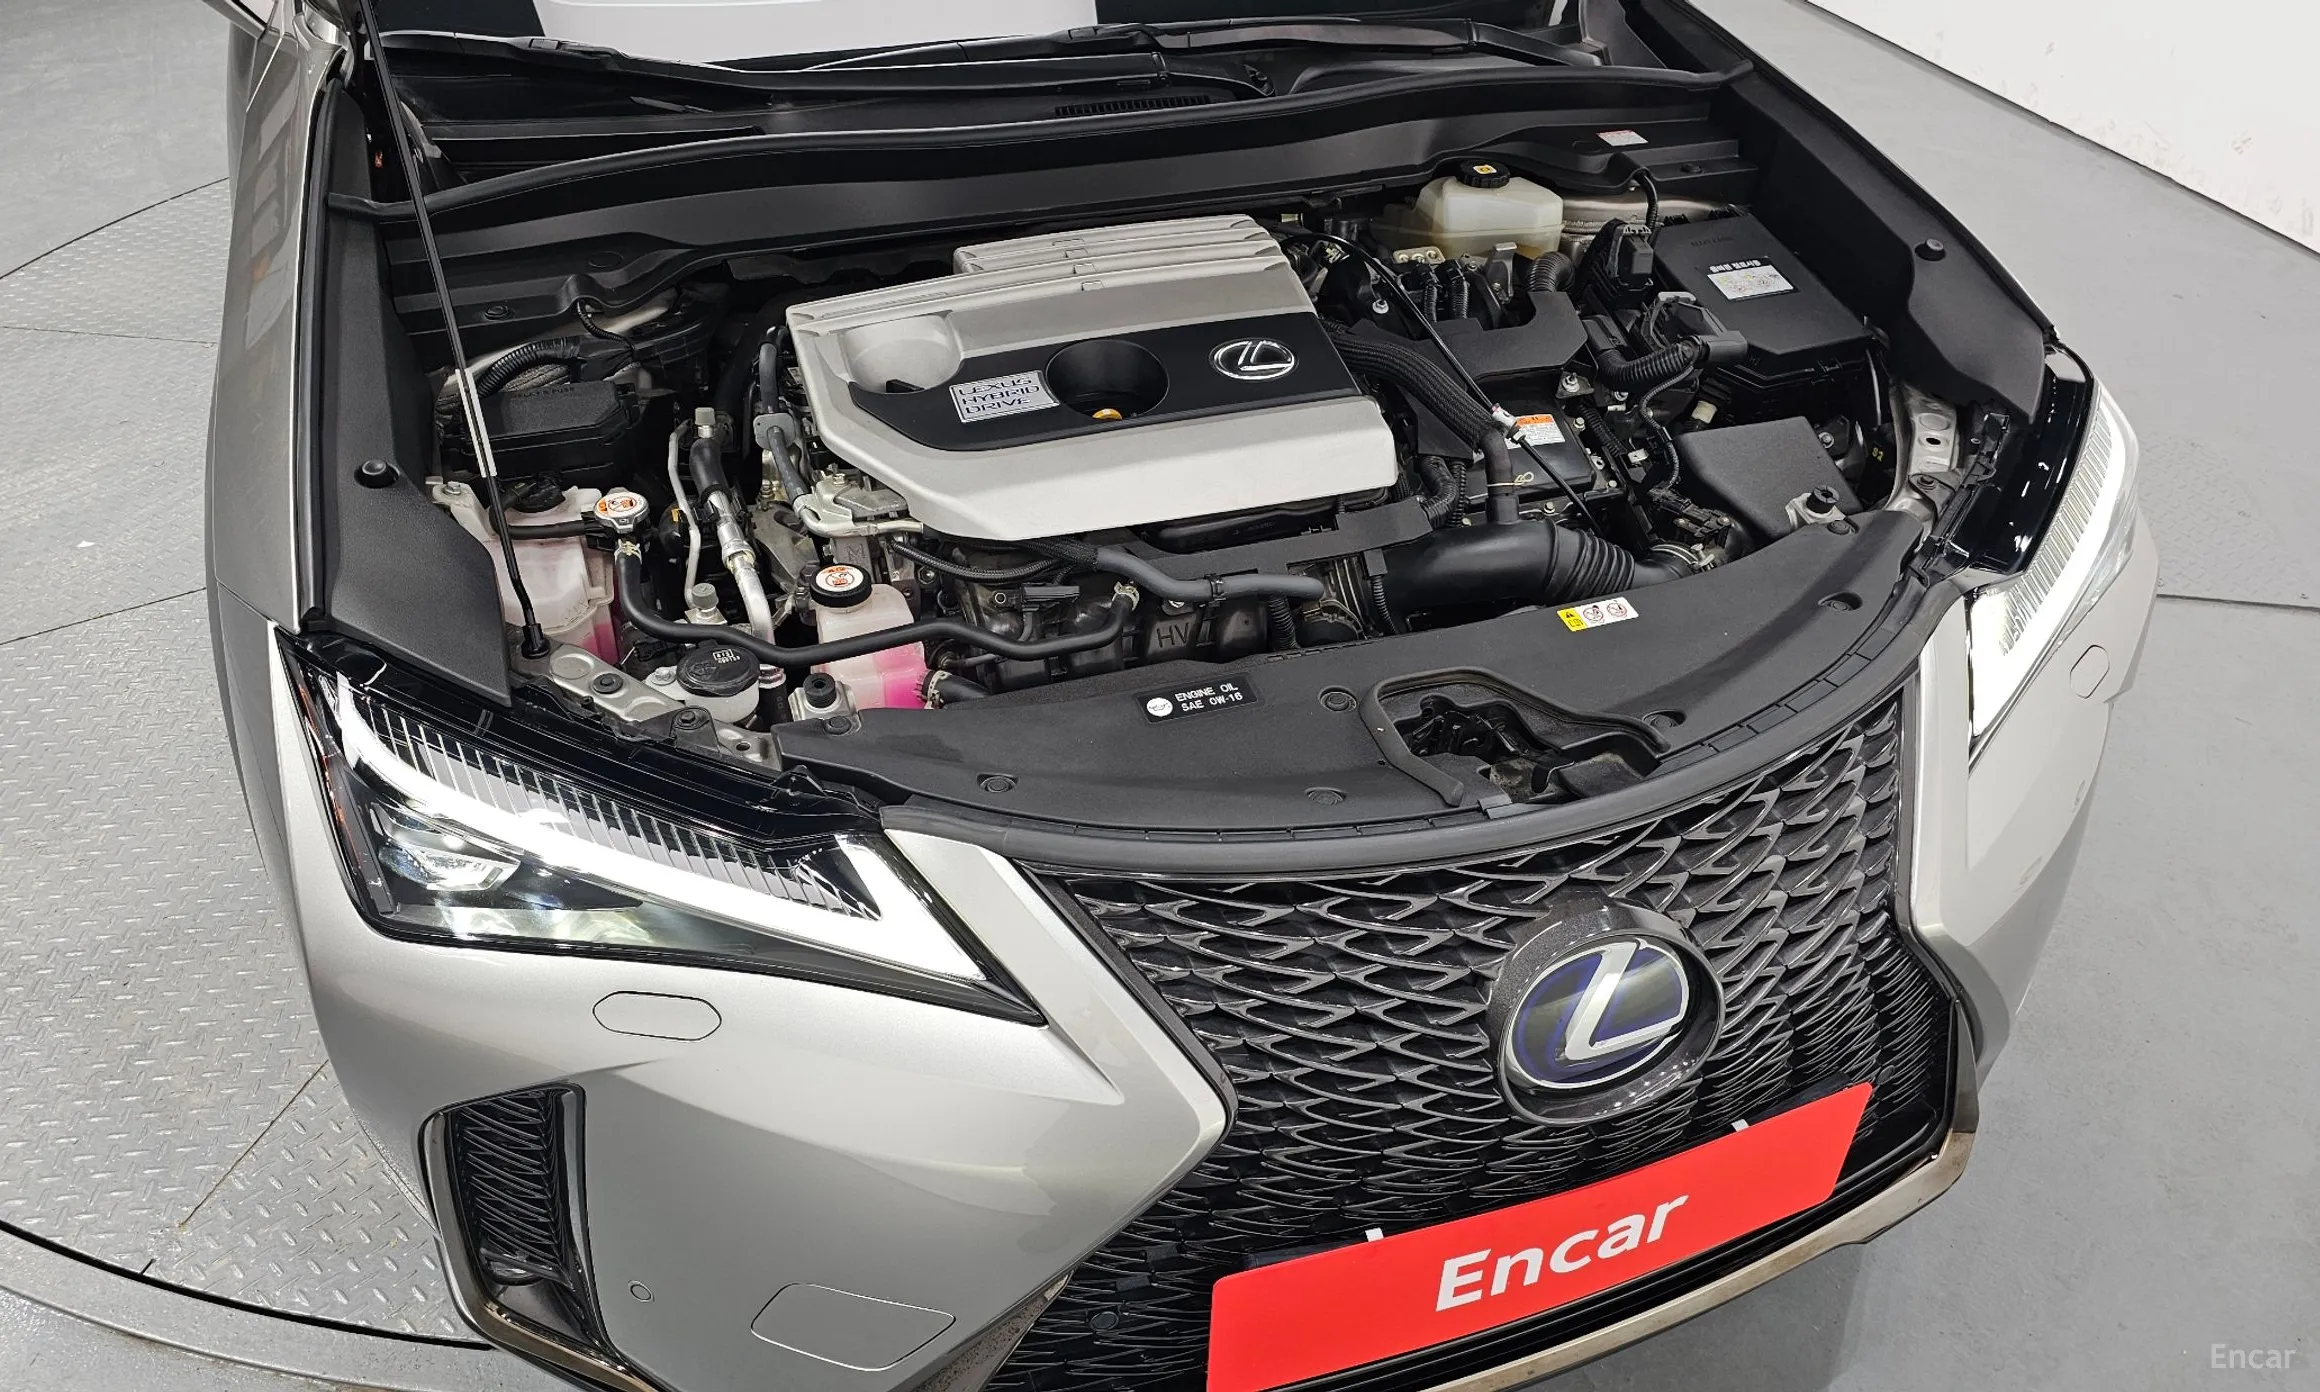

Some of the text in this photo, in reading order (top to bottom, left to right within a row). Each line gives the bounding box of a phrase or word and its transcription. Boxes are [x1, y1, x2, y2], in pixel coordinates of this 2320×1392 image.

[959, 378, 1032, 396] LEXUS
[962, 386, 1040, 405] HYBRID
[965, 398, 1031, 413] DRIVE
[1157, 622, 1189, 648] HV
[1175, 683, 1239, 702] ENGINE OIL
[1181, 692, 1244, 712] SAE 0W-16
[1435, 1195, 1689, 1312] Encar
